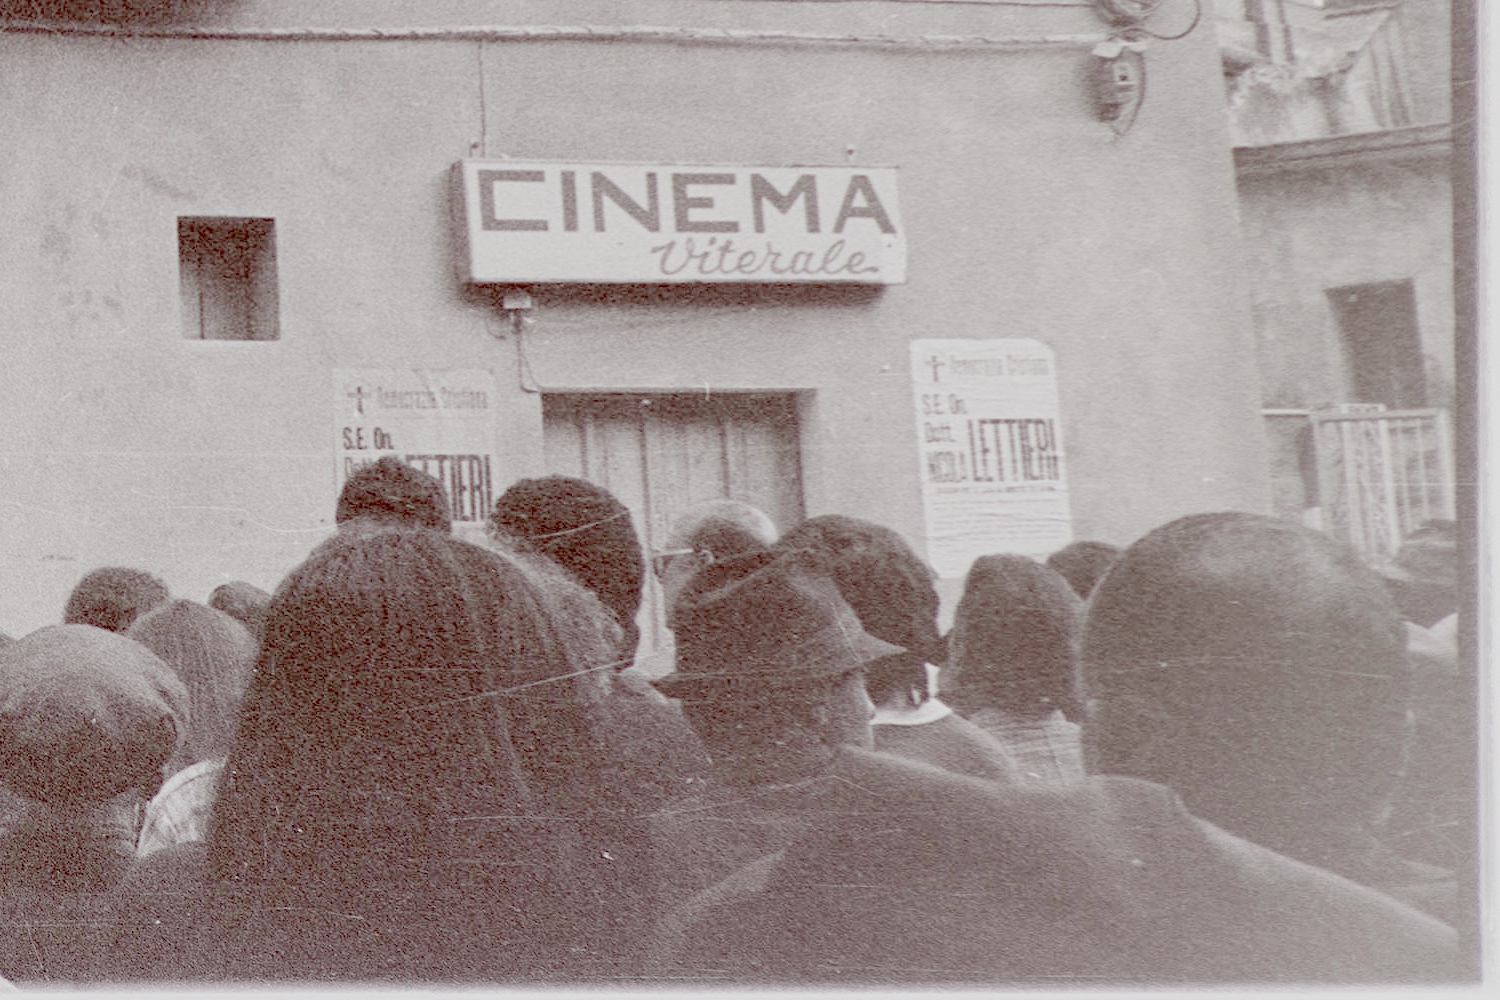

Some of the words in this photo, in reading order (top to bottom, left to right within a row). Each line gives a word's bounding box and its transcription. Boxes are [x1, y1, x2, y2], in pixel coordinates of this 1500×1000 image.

[478, 170, 897, 234] CINEMA
[651, 236, 880, 277] Viterale
[968, 419, 1060, 482] LETTIERI
